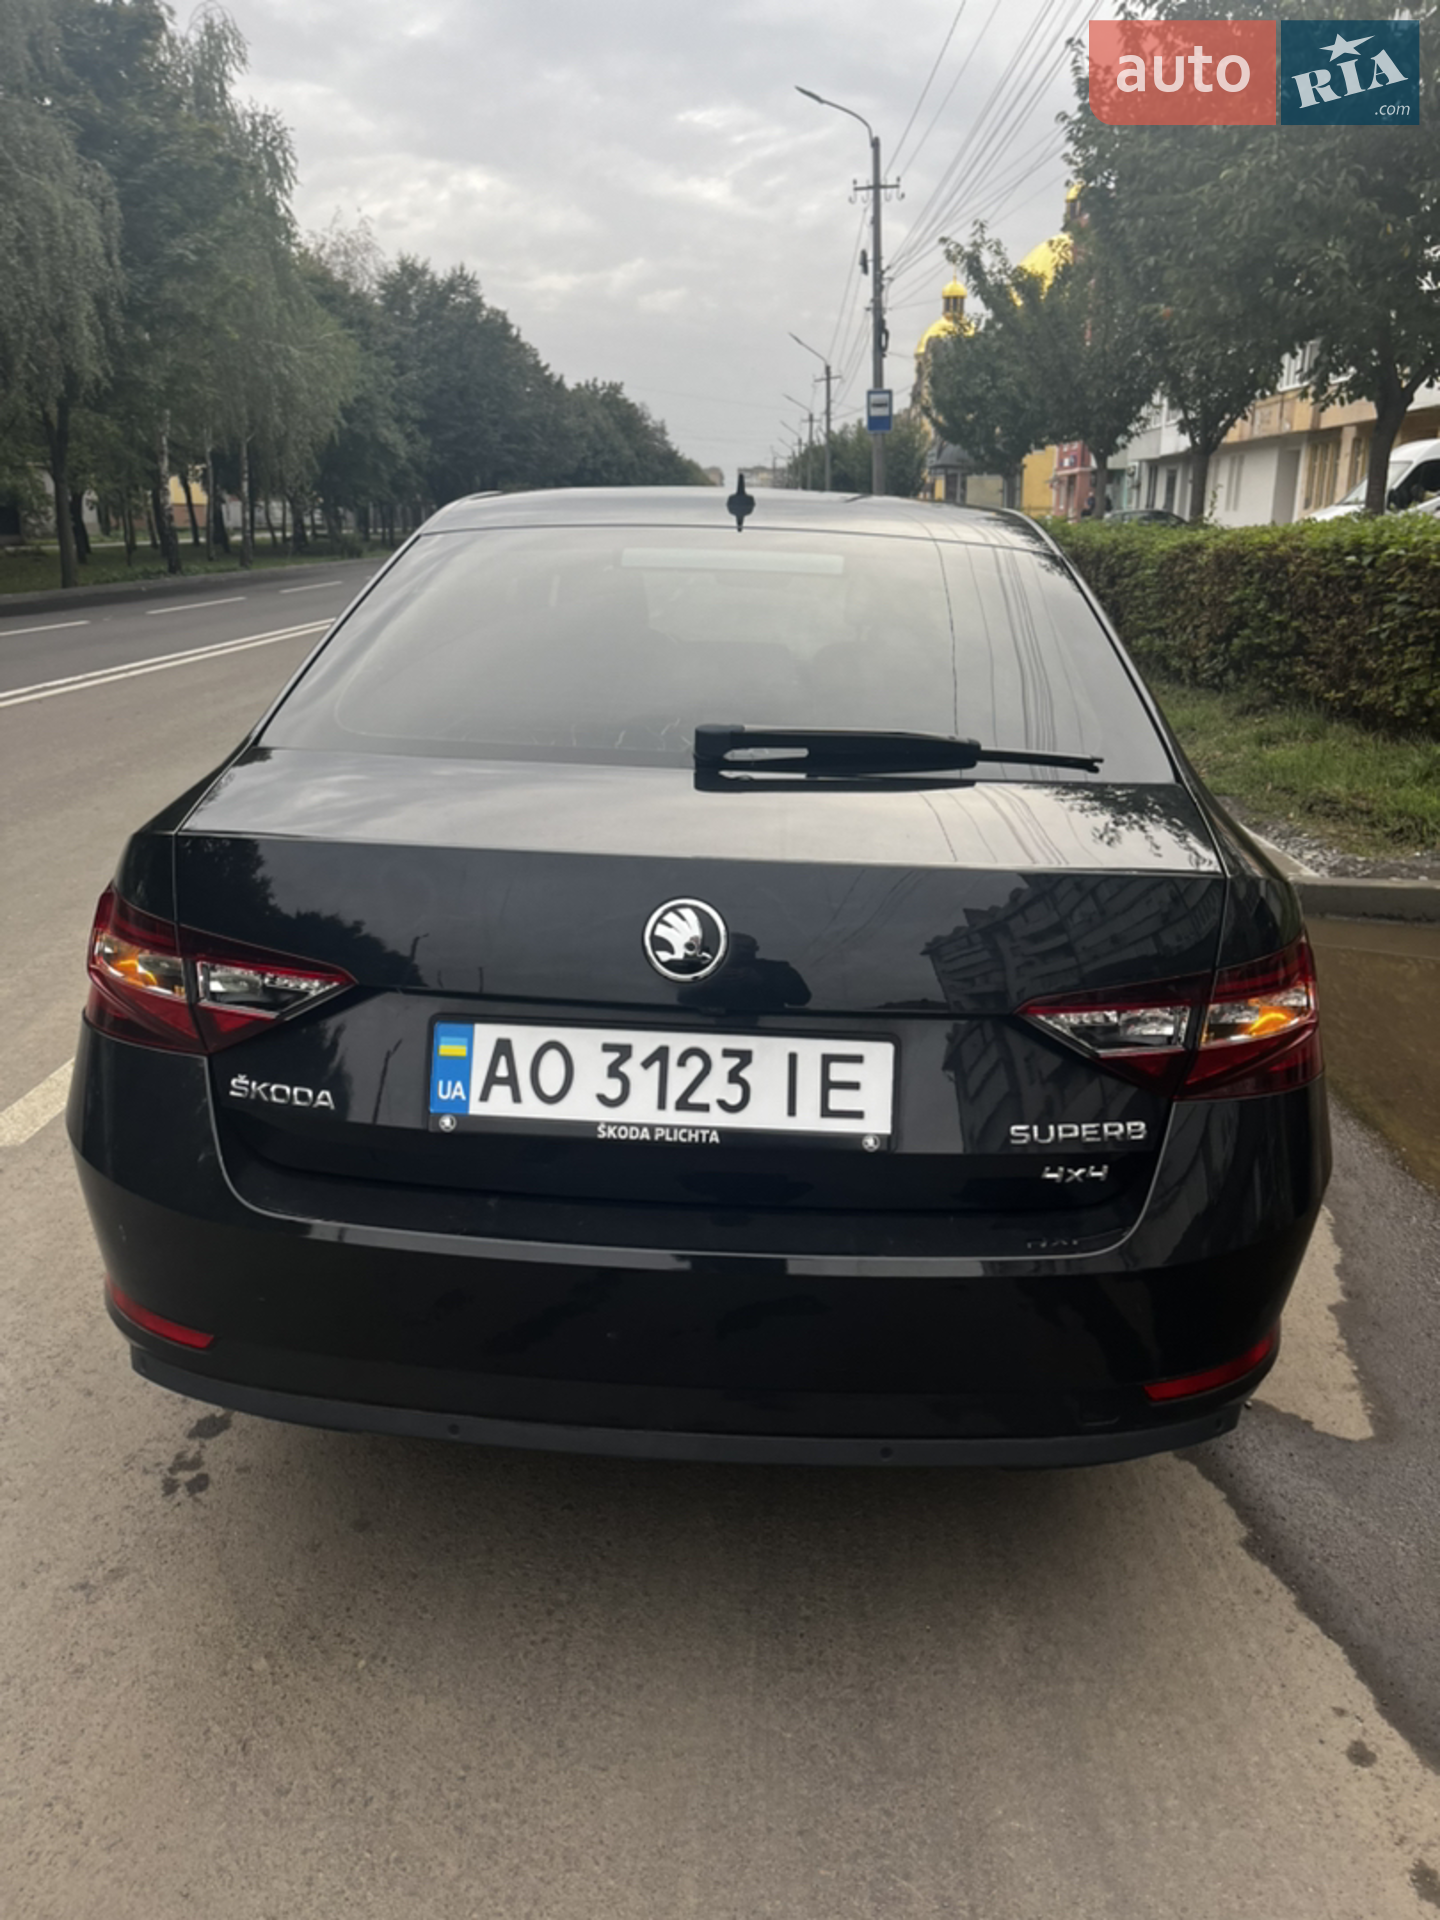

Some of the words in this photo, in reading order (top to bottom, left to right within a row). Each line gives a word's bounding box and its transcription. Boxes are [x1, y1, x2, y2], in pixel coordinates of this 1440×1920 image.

[437, 1080, 466, 1100] UA
[478, 1038, 575, 1105] AO
[595, 1042, 754, 1114] 3123
[786, 1052, 865, 1119] IE
[229, 1074, 335, 1110] ŠKODA
[596, 1123, 651, 1142] ŠKODA
[654, 1127, 720, 1145] PLICHTA
[1009, 1120, 1147, 1145] SUPERB
